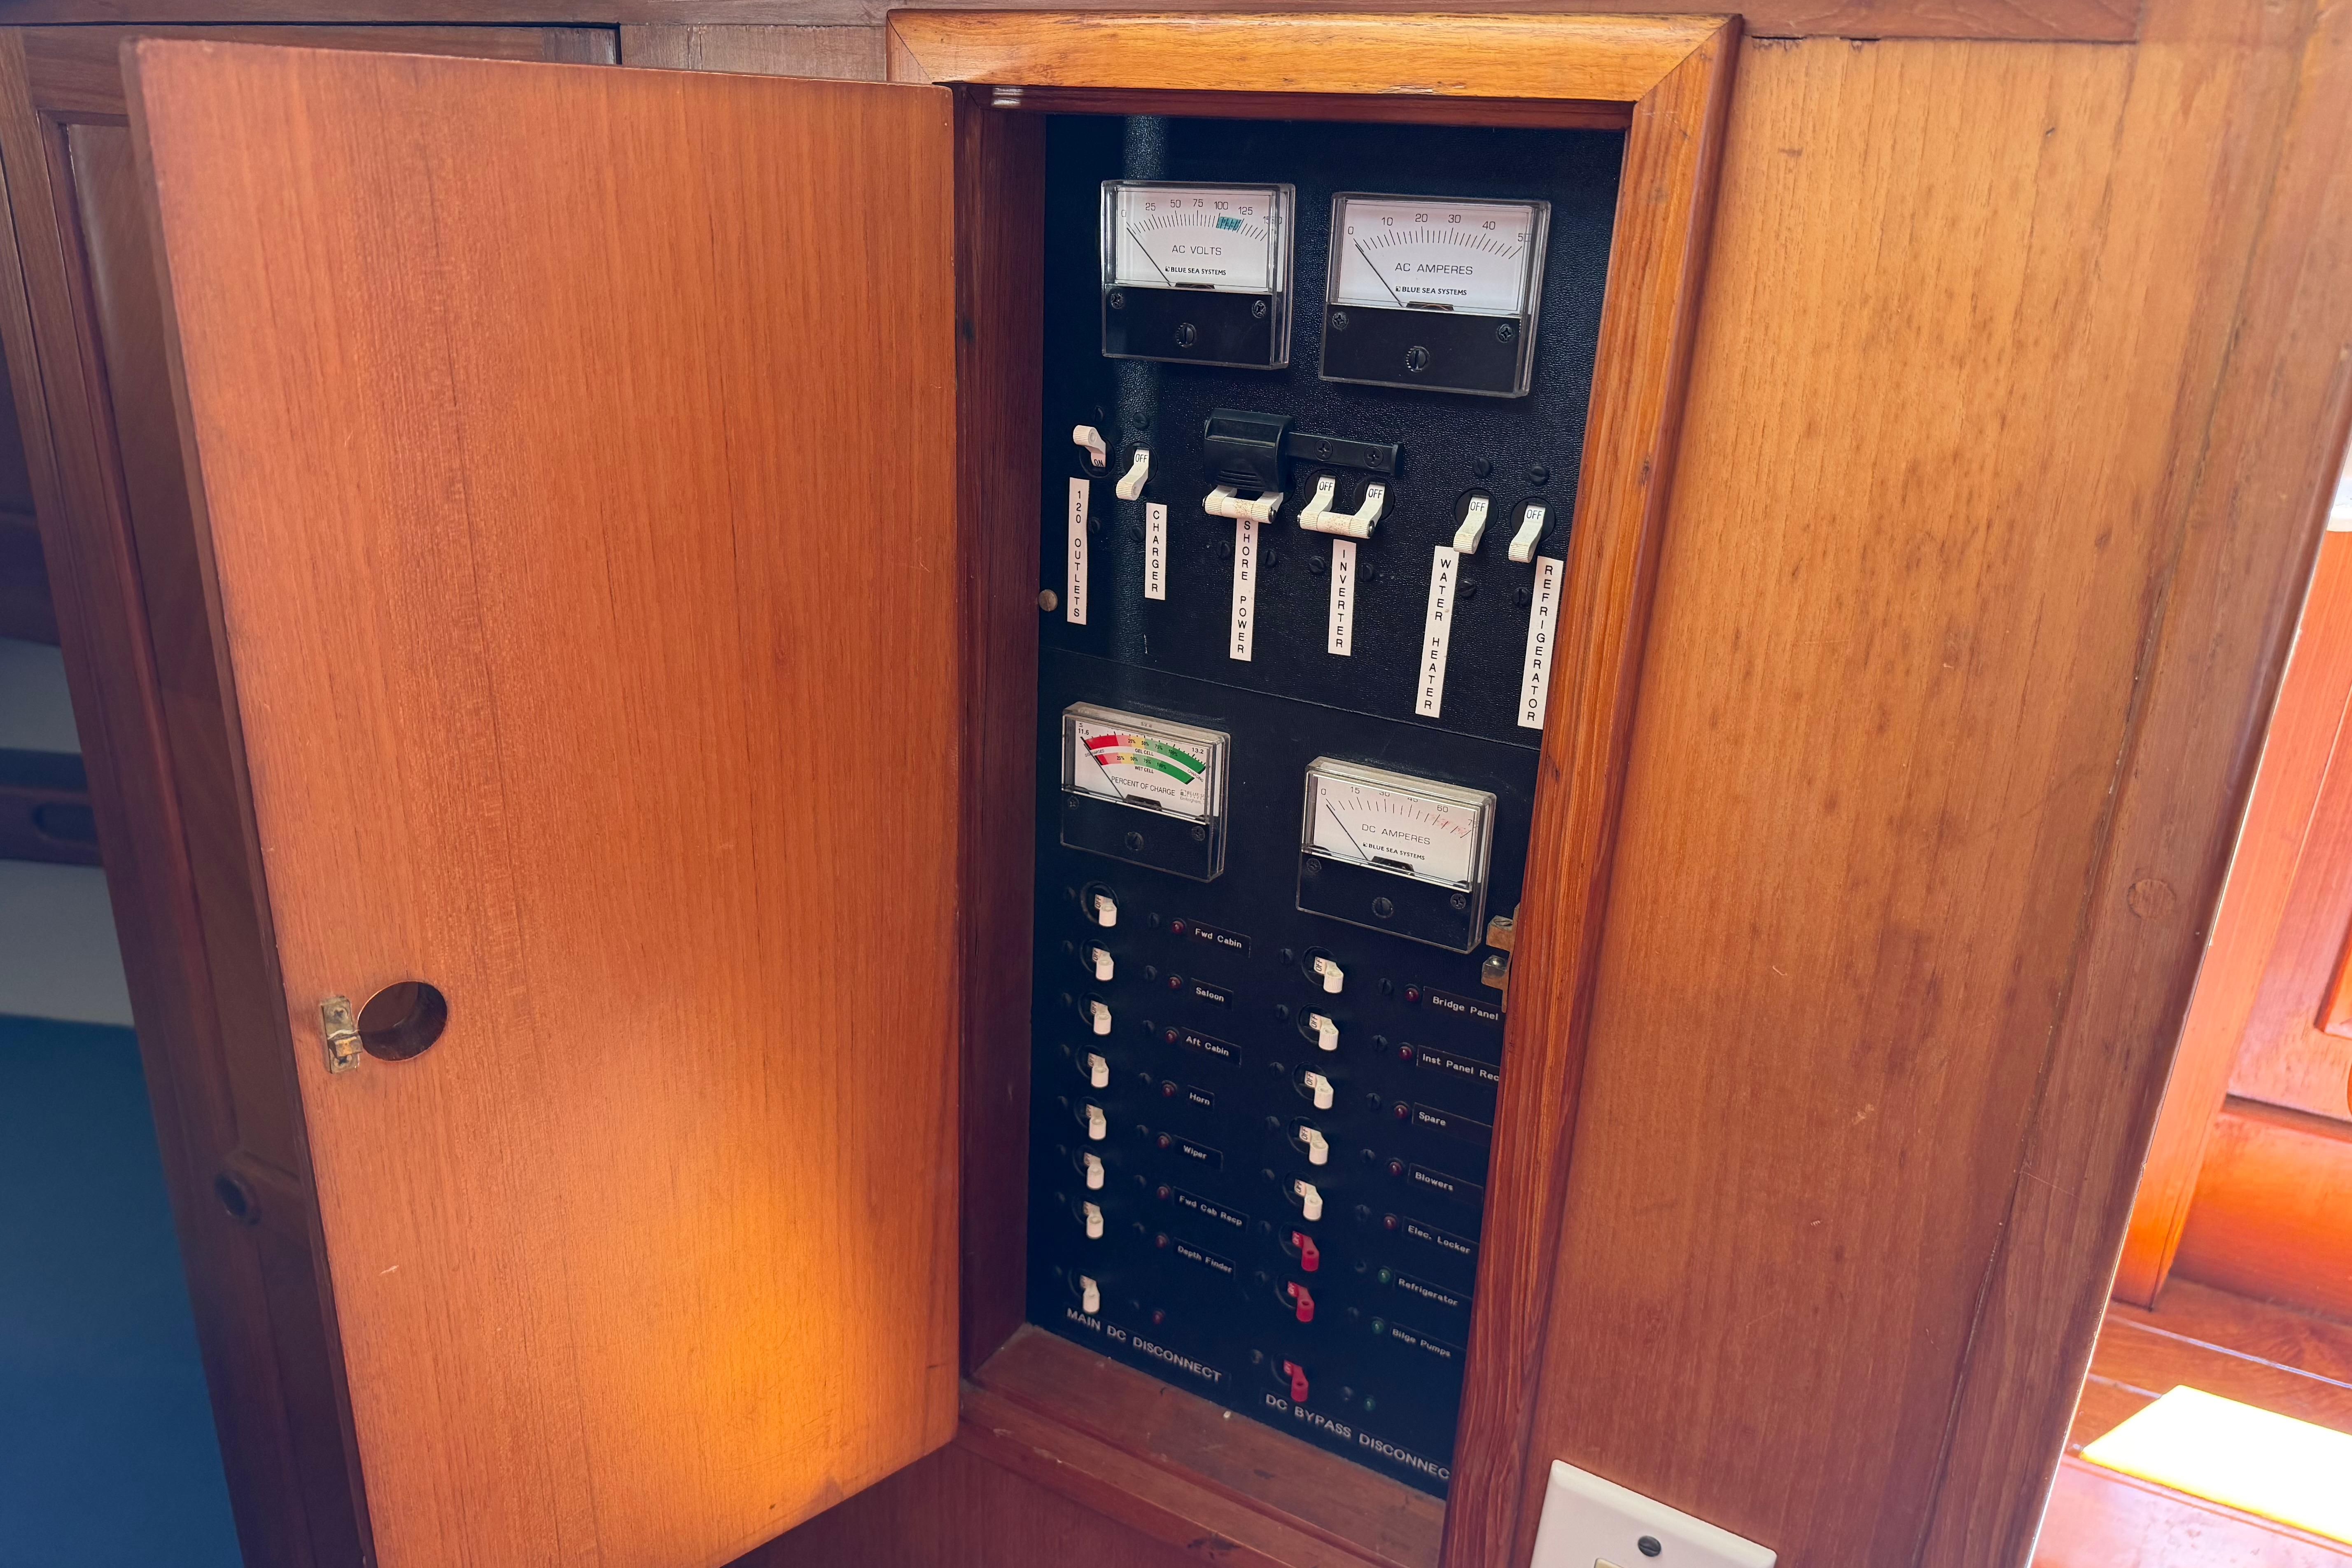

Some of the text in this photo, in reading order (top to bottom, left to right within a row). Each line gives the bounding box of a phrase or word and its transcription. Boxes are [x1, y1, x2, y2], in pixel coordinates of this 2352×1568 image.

[1171, 200, 1181, 208] 50
[1214, 201, 1228, 210] 100
[1239, 207, 1253, 215] 125
[1348, 226, 1353, 235] 0
[1382, 217, 1393, 226] 10
[1415, 213, 1428, 222] 20
[1448, 215, 1461, 223] 30
[1482, 221, 1496, 230] 40
[1172, 245, 1221, 256] AC VOLTS
[1395, 263, 1473, 275] AC AMPERES
[1135, 454, 1148, 463] OFF
[1319, 482, 1333, 491] OFF
[1369, 488, 1383, 499] OFF
[1470, 502, 1485, 511] OFF
[1526, 510, 1542, 519] OFF
[1073, 538, 1082, 617] OUTLETS
[1237, 521, 1251, 653] SHORE POWER
[1336, 550, 1347, 648] INVERTER
[1424, 559, 1451, 709] WATER HEATER
[1527, 565, 1553, 721] REFRIGERATOR
[1112, 776, 1139, 788] PERCENT
[1150, 785, 1175, 796] CHARGE
[1362, 824, 1430, 845] DC AMPERES
[1369, 843, 1384, 851] BLUE
[1400, 850, 1425, 860] SYSTEMS
[1195, 928, 1242, 948] Fwd Cabin
[1196, 987, 1225, 1002] Saloon
[1433, 996, 1498, 1020] Bridge Panel
[1186, 1036, 1230, 1056] Aft Cabin
[1423, 1053, 1441, 1066] Inst
[1446, 1060, 1474, 1074] Panel
[1190, 1092, 1210, 1106] Horn
[1419, 1112, 1446, 1127] Spare
[1183, 1145, 1207, 1160] Wiper
[1415, 1172, 1454, 1191] Blowers
[1179, 1196, 1197, 1208] Fwd
[1201, 1204, 1218, 1218] Cab
[1408, 1225, 1470, 1254] Elec. Locker
[1178, 1245, 1232, 1274] Depth Finder
[1398, 1278, 1458, 1306] Refrigerator
[1067, 1308, 1222, 1383] MAIN DC DISCONNECT
[1392, 1328, 1451, 1358] Bilge Pumps
[1265, 1393, 1288, 1411] DC
[1294, 1405, 1352, 1439] BYPASS
